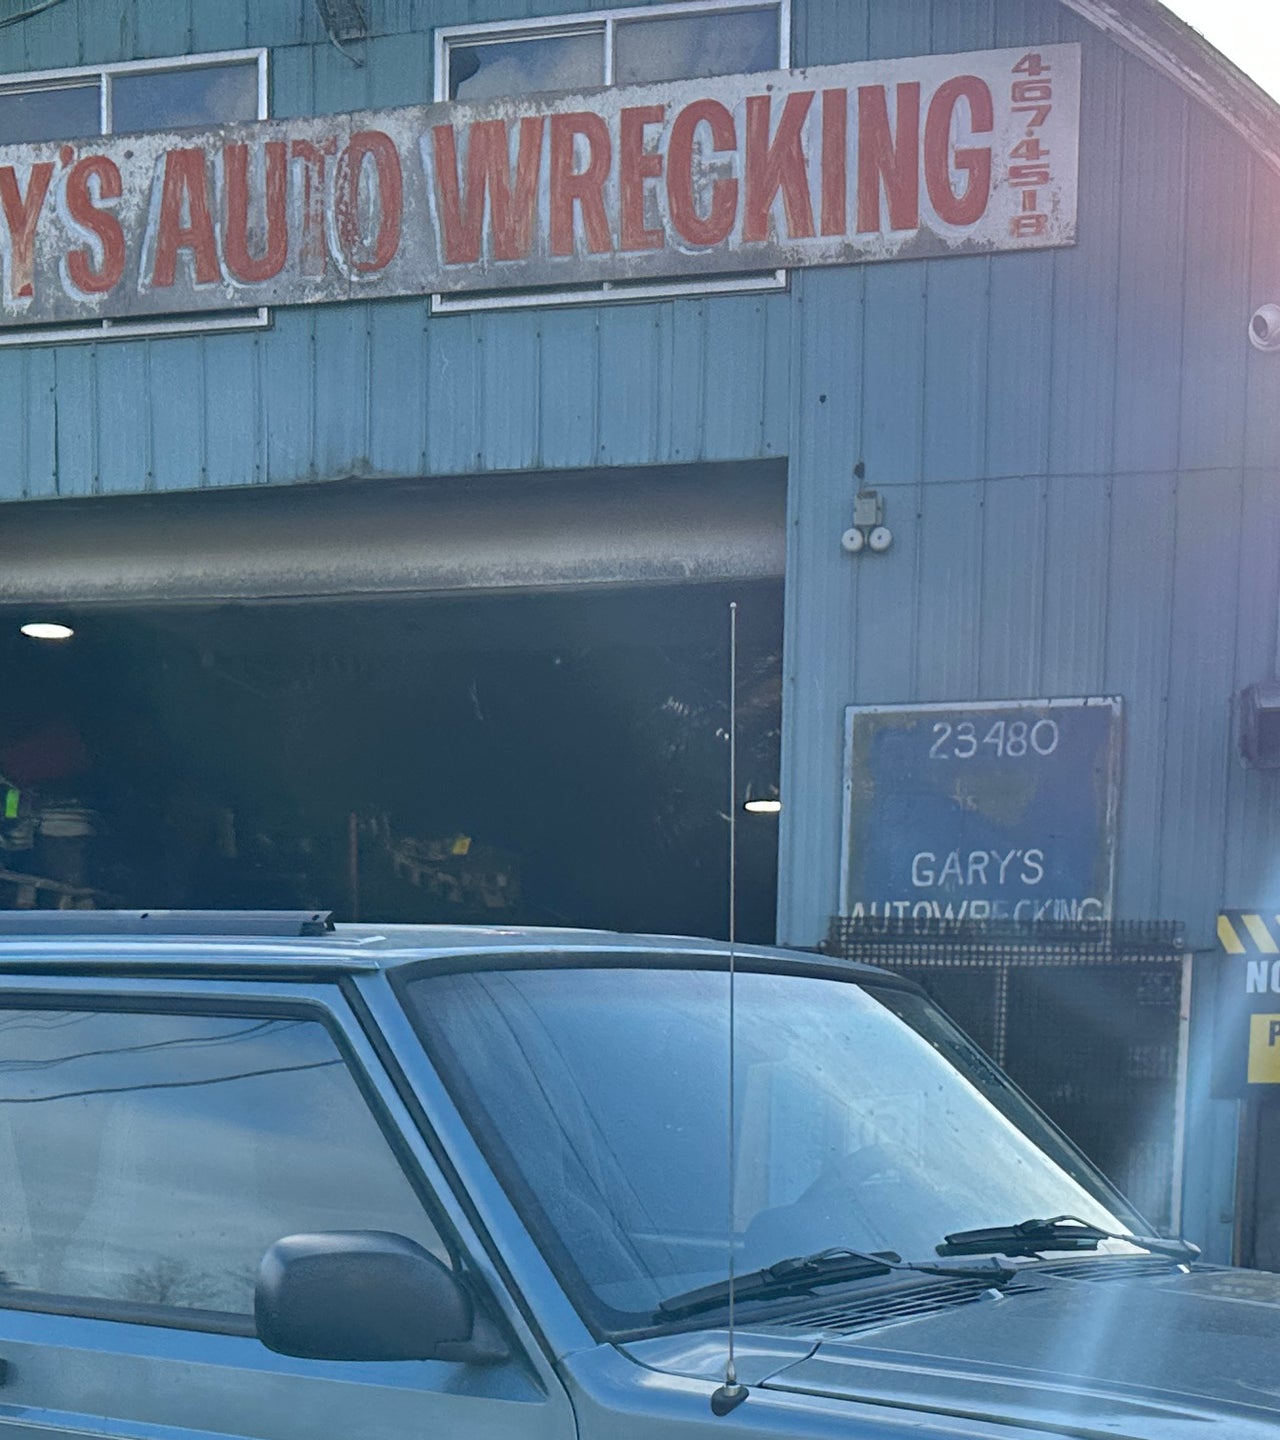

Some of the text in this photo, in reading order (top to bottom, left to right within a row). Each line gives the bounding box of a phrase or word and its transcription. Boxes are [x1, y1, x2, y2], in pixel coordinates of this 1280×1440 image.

[148, 130, 404, 290] AUTO
[432, 74, 994, 266] WRECKING
[929, 719, 1059, 760] 23480
[911, 848, 1045, 887] GARY'S
